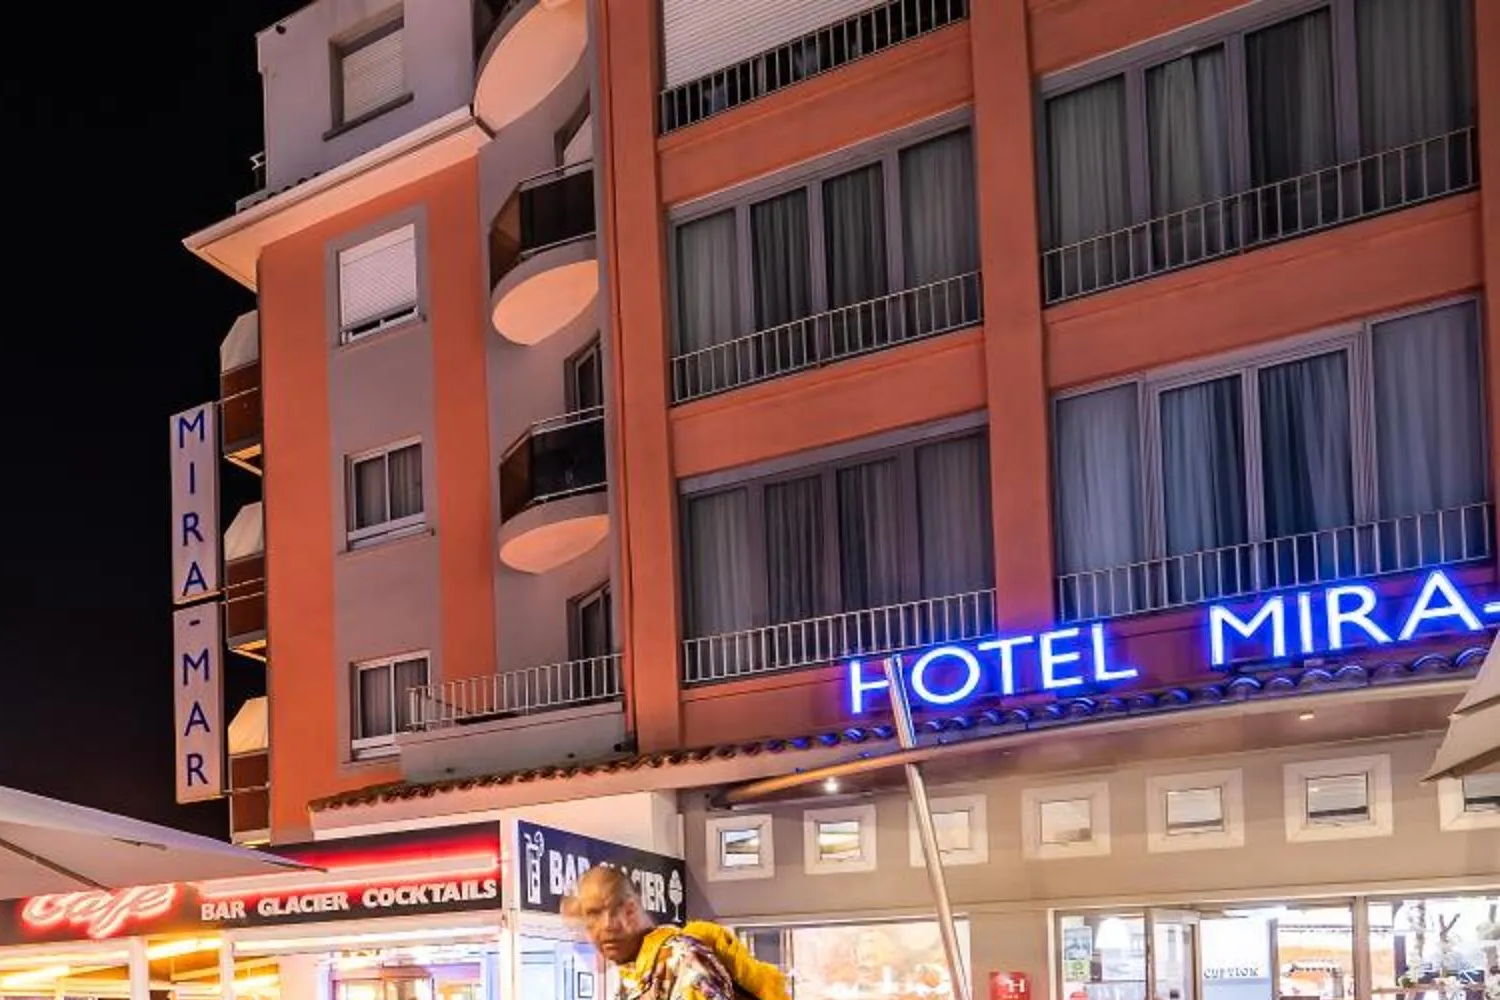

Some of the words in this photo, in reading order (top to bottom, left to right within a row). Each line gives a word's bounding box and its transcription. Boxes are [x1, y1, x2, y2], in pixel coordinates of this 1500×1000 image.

[850, 622, 1138, 715] HOTEL
[200, 899, 247, 922] BAR
[256, 892, 350, 918] GLACIER
[362, 880, 498, 909] COCKTAILS
